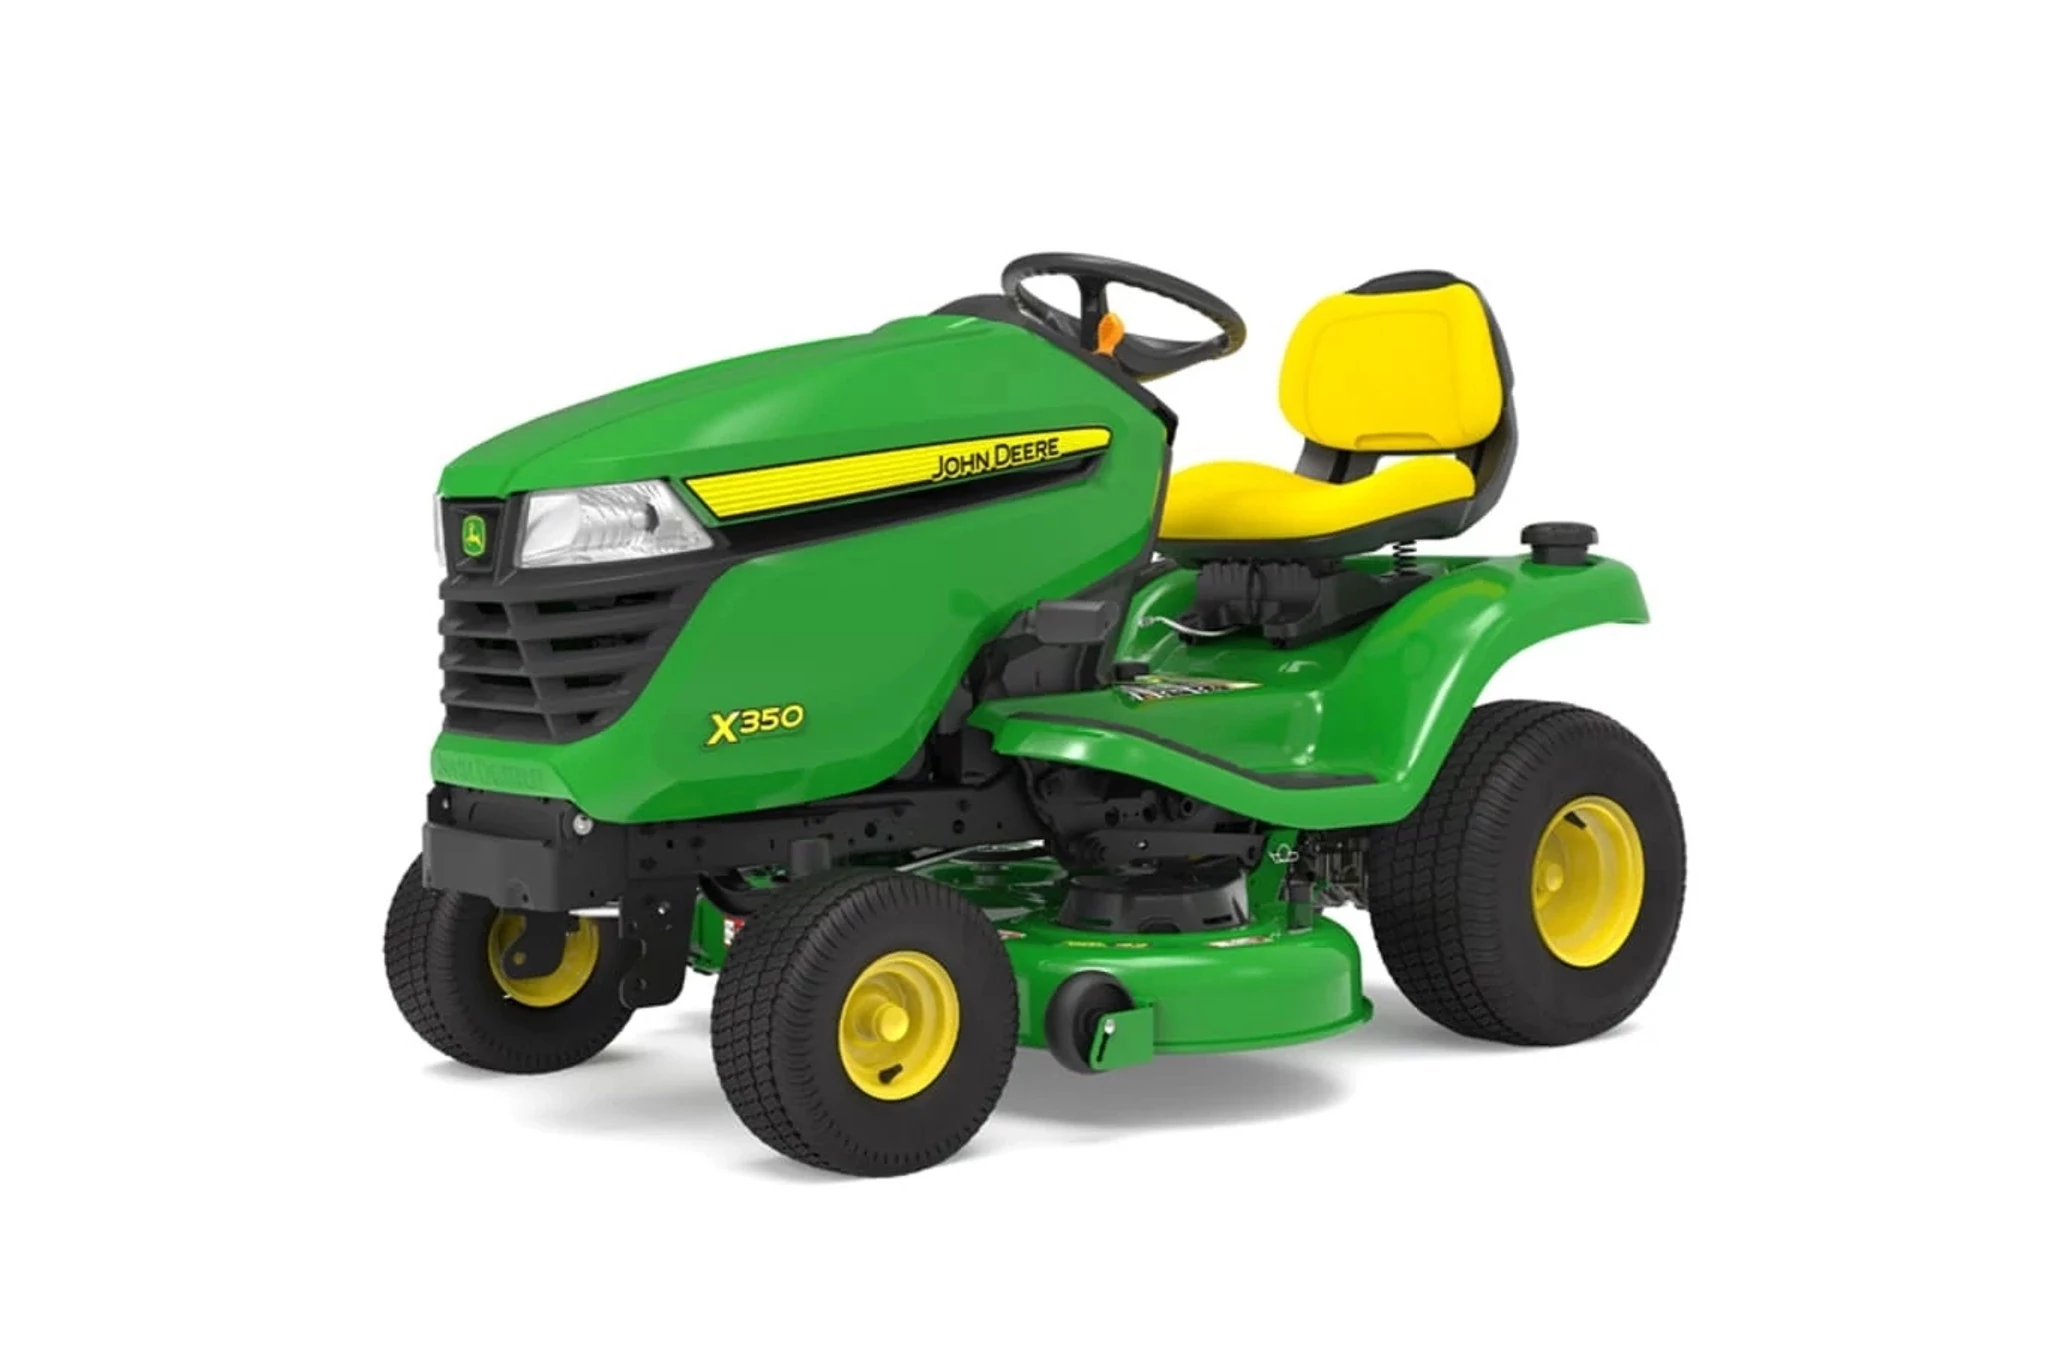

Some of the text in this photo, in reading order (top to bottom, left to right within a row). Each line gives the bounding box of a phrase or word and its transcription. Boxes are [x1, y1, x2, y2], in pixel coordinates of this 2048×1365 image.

[932, 437, 1060, 478] JOHN DEERE
[705, 703, 805, 746] X350
